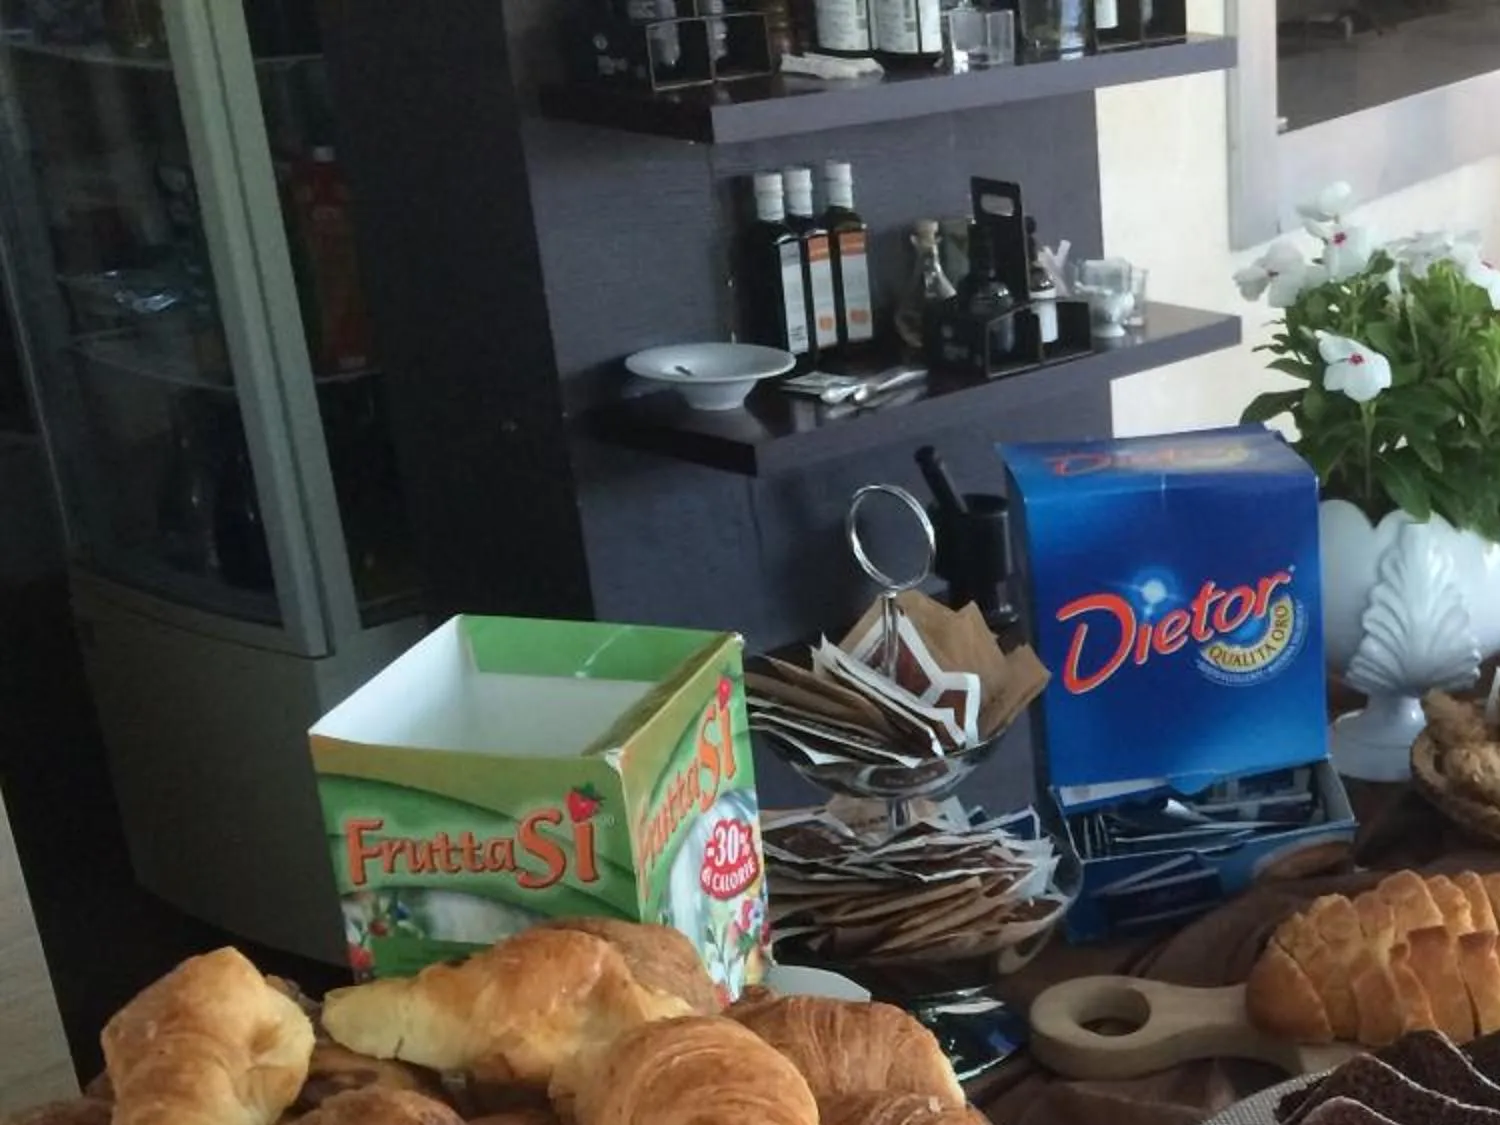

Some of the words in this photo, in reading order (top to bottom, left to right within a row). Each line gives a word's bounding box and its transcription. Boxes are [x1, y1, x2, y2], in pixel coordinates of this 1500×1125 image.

[1056, 571, 1291, 695] Dietor
[1271, 604, 1290, 642] ORO
[707, 825, 750, 867] -30%
[712, 857, 756, 892] CALORIE
